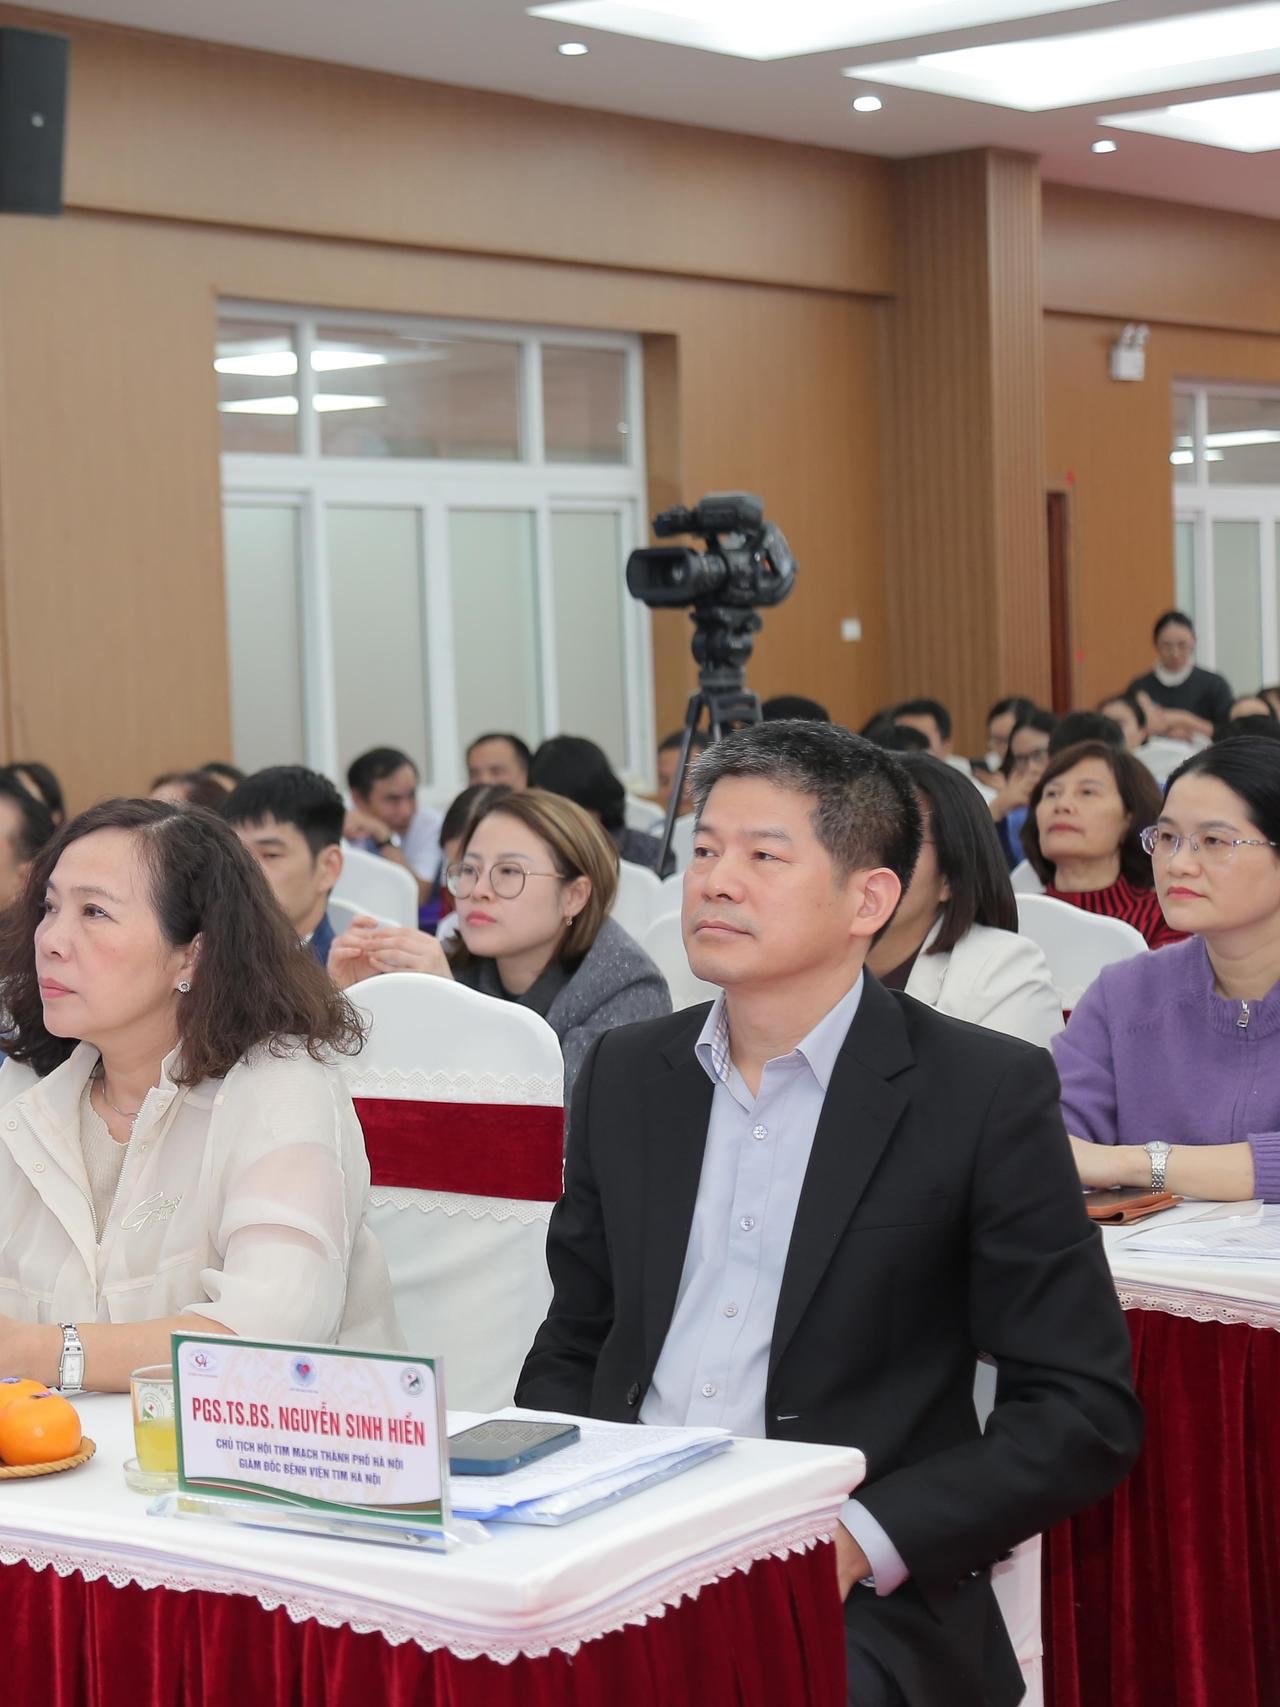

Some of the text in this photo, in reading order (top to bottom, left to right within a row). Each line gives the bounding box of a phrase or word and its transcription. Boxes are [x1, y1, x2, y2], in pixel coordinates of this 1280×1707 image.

[192, 1397, 274, 1429] PGS.TS.BS.
[279, 1402, 340, 1436] NGUYỄN
[346, 1414, 382, 1441] SINH
[388, 1411, 425, 1445] HIỂN
[216, 1438, 404, 1472] CHỦ TỊCH HỘI TIM MẠCH THÀNH PHỐ HÀ NỘI
[284, 1462, 307, 1477] BỆNH
[310, 1466, 330, 1480] VIỆN
[332, 1470, 349, 1481] TIM
[351, 1470, 362, 1483] HÀ
[365, 1472, 381, 1487] NỘI
